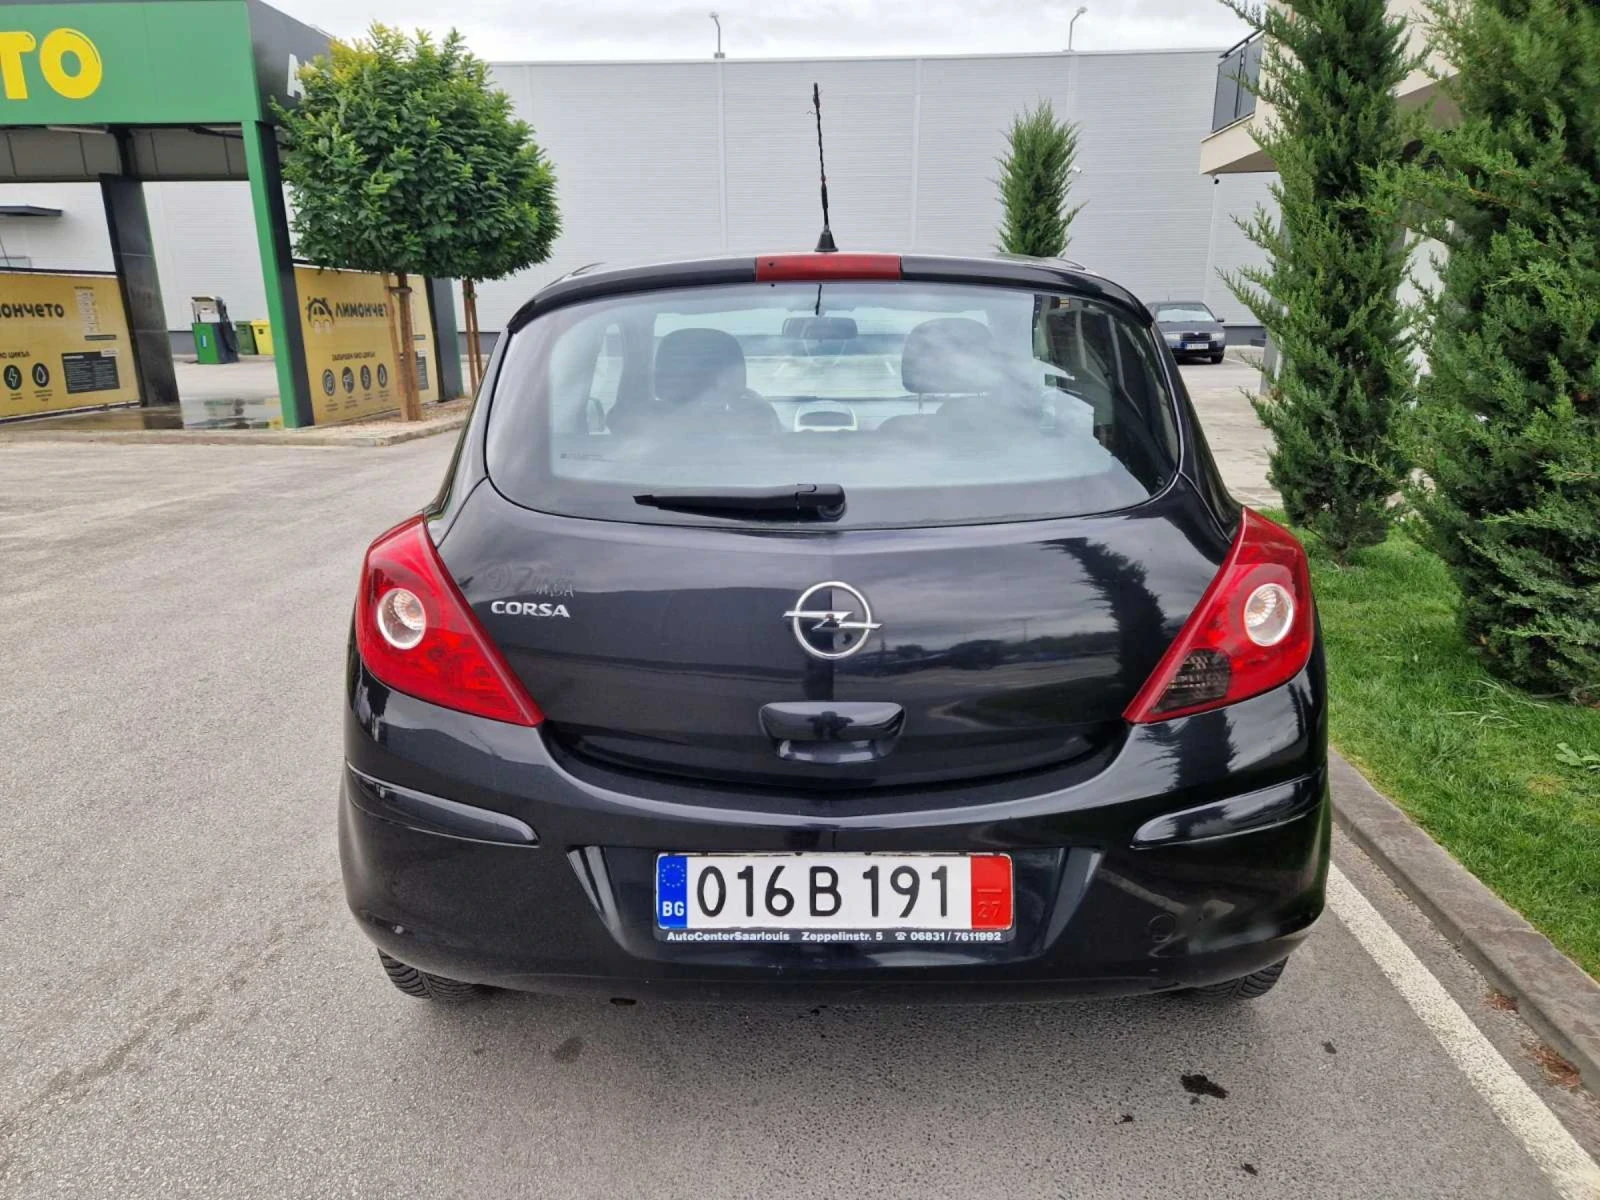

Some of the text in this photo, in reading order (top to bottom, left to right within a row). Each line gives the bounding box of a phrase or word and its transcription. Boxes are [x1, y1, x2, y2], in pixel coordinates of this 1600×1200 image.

[0, 303, 64, 318] ончето
[491, 601, 570, 618] CORSA
[697, 865, 948, 918] 016 B 191
[662, 901, 685, 917] BG
[667, 931, 790, 942] AutoCenterSaarlouis
[801, 931, 872, 943] Zeppelinstr.
[875, 931, 883, 941] 5
